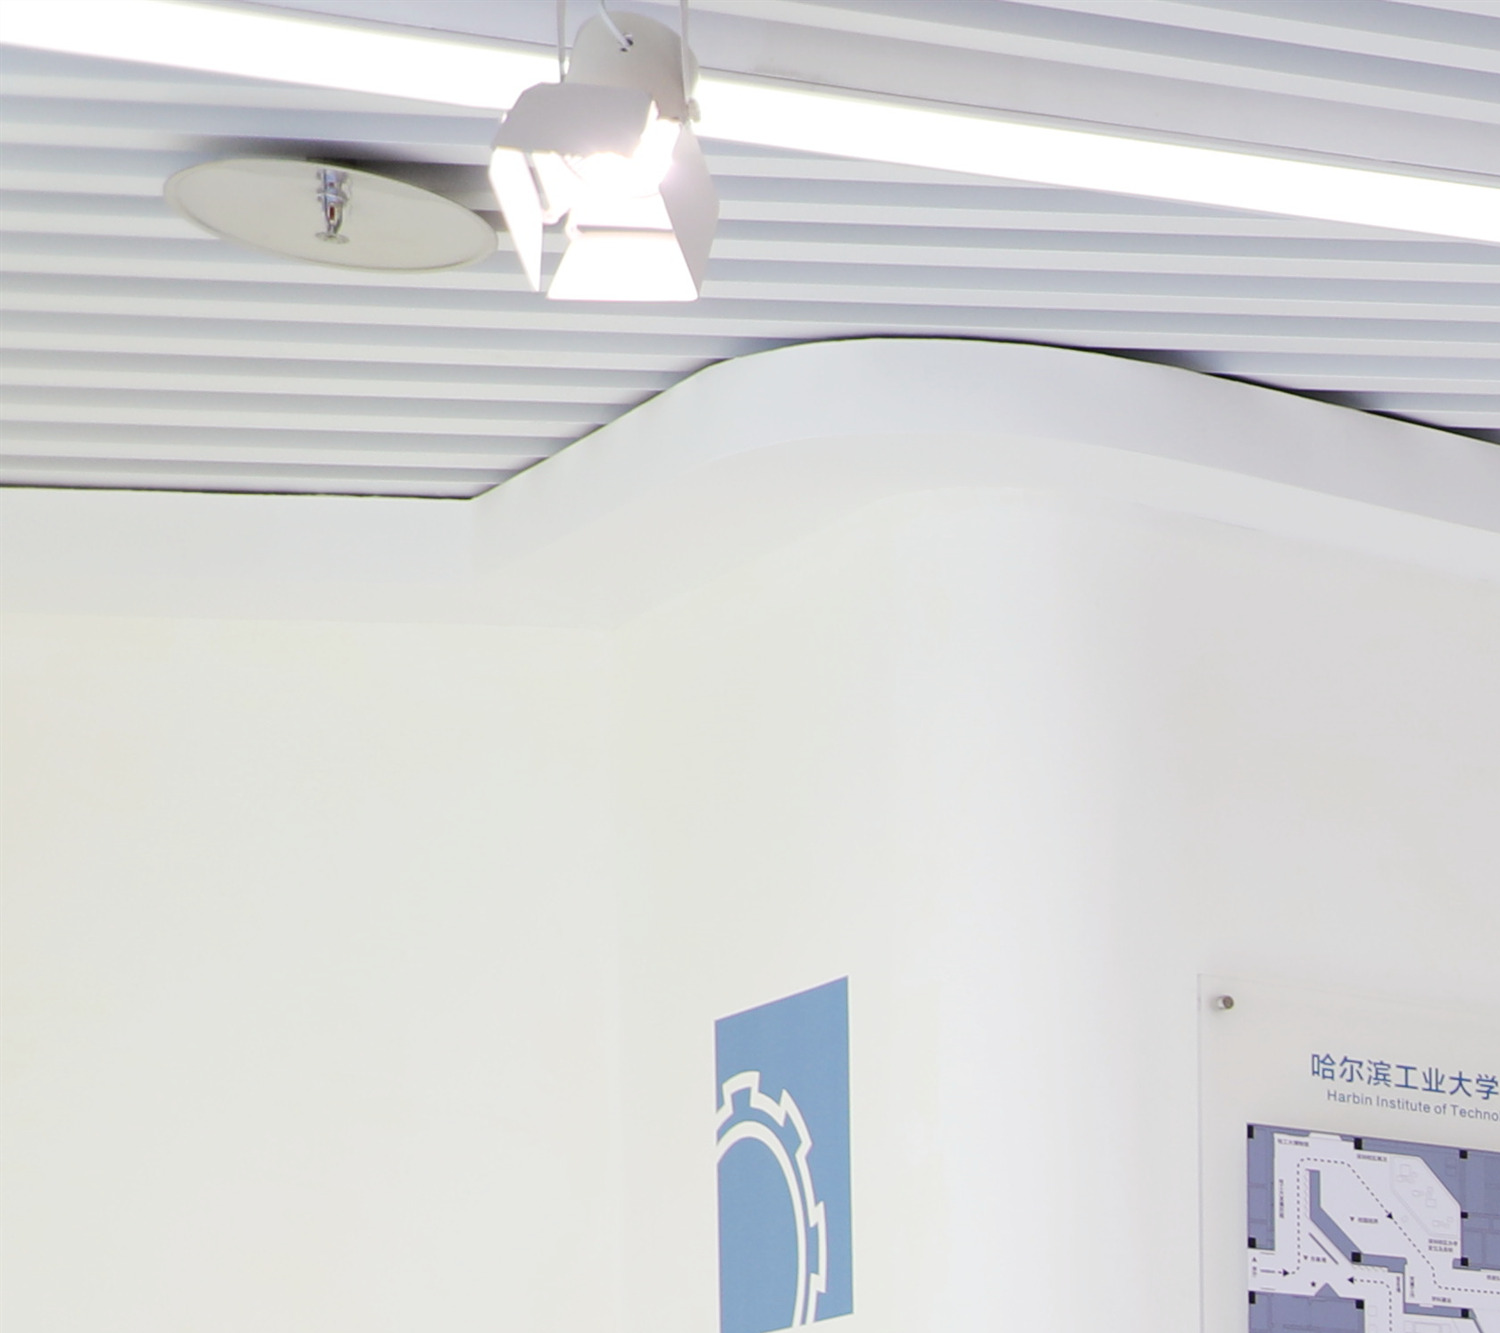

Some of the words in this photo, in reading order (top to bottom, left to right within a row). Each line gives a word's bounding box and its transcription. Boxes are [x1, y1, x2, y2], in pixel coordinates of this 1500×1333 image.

[1326, 1089, 1373, 1110] Harbin
[1376, 1094, 1430, 1116] Institute
[1434, 1101, 1448, 1115] of
